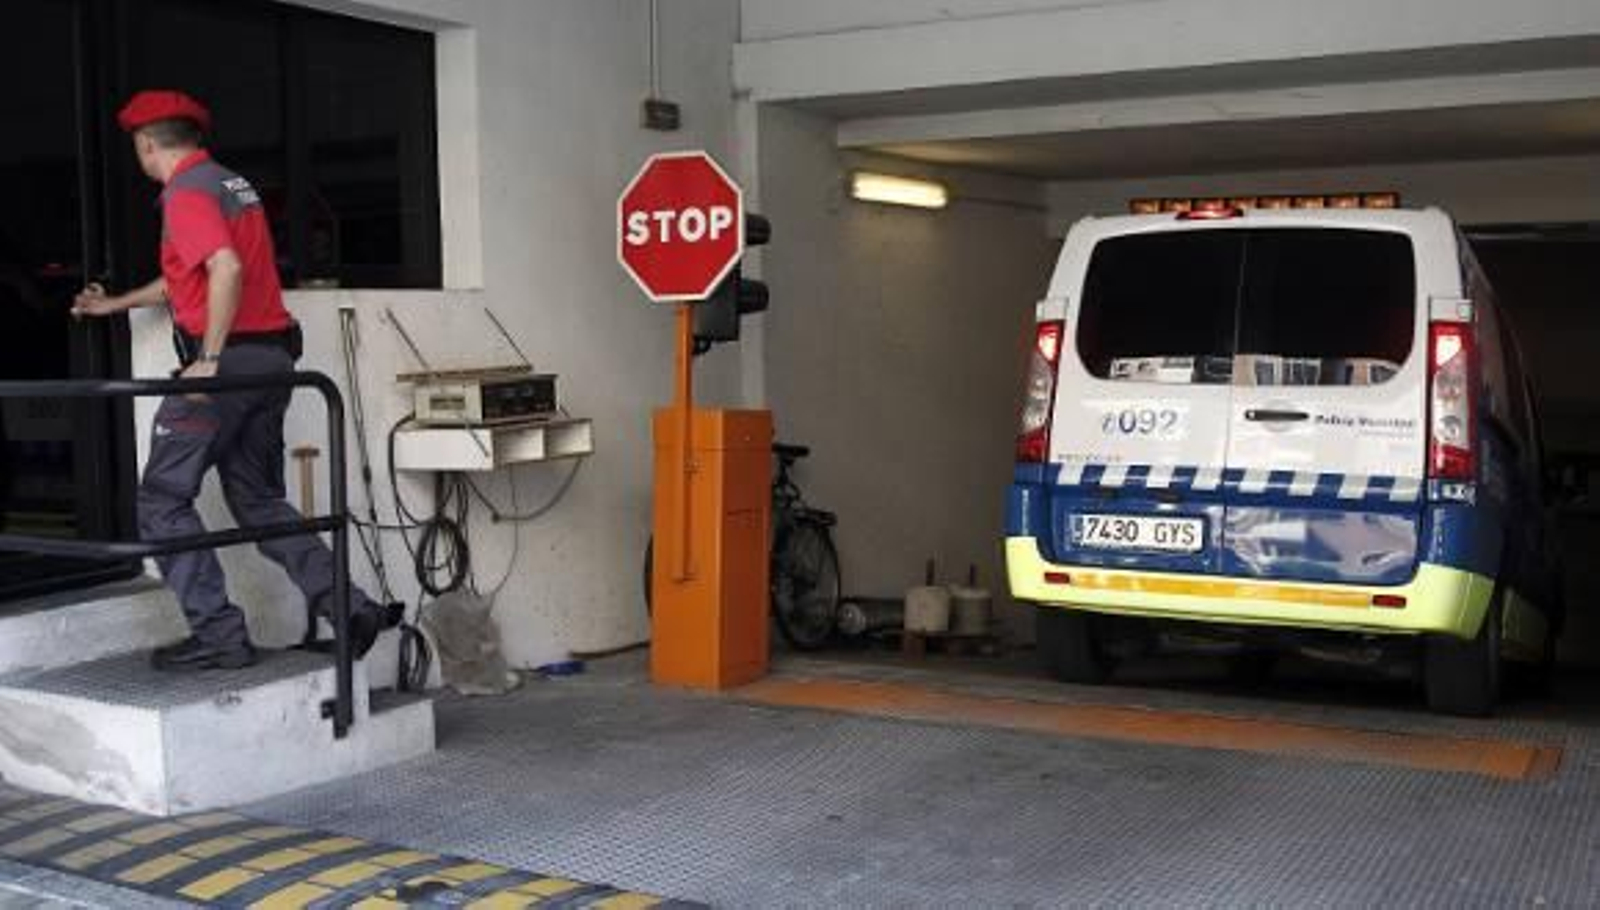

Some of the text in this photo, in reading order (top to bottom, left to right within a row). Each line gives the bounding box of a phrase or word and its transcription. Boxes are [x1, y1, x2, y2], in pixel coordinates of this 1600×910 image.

[625, 205, 733, 246] STOP
[1118, 408, 1179, 434] 092
[1086, 516, 1195, 545] 7430 GYS
